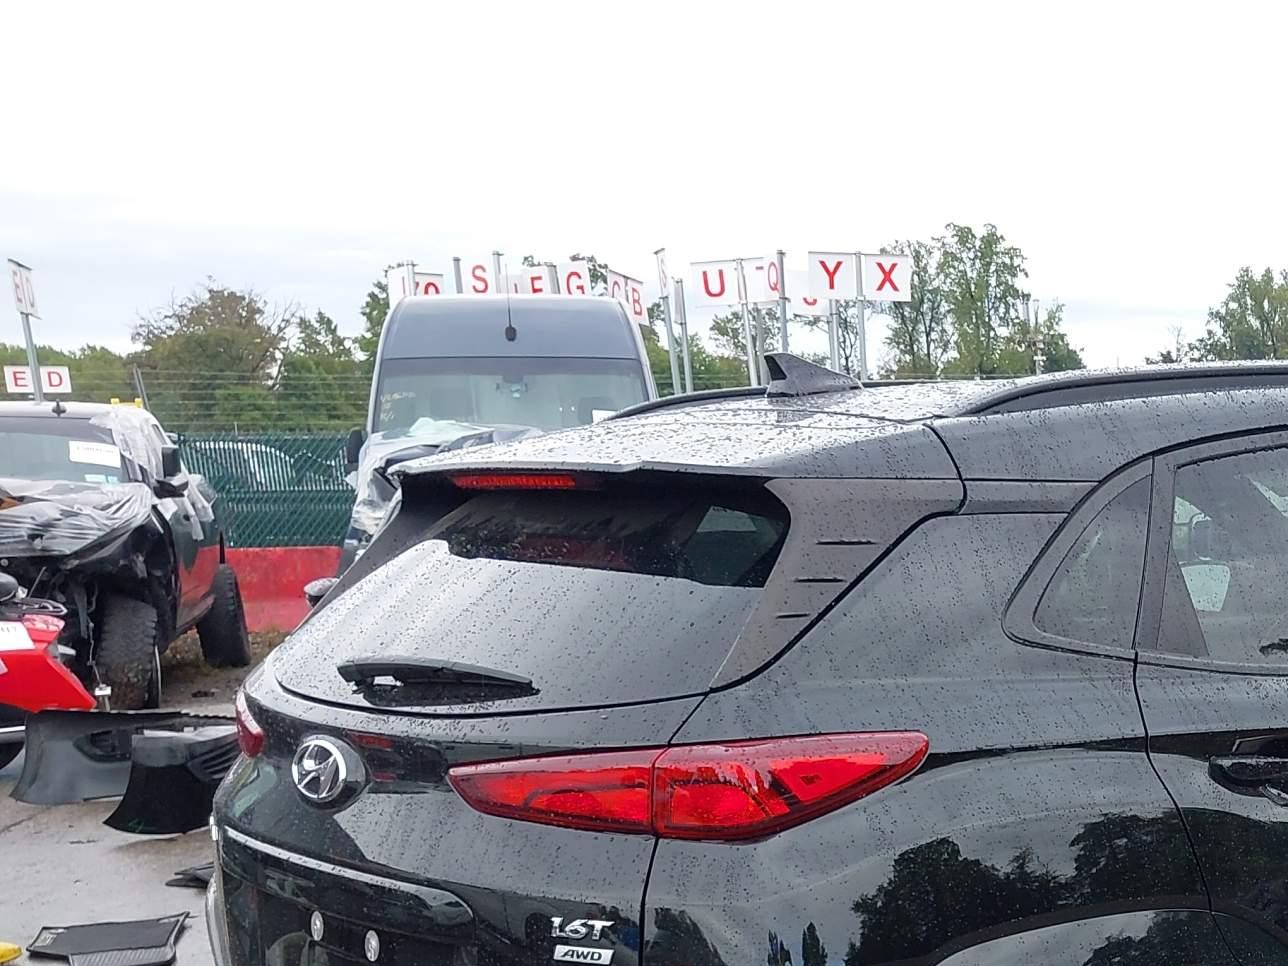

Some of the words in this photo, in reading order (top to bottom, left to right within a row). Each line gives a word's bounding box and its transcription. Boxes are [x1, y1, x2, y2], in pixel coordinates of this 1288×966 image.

[471, 264, 489, 294] S
[702, 269, 726, 298] U
[819, 260, 844, 290] Y
[875, 262, 900, 292] X
[631, 287, 643, 316] B
[12, 371, 29, 387] E
[47, 371, 63, 387] D
[560, 949, 603, 961] AWD
